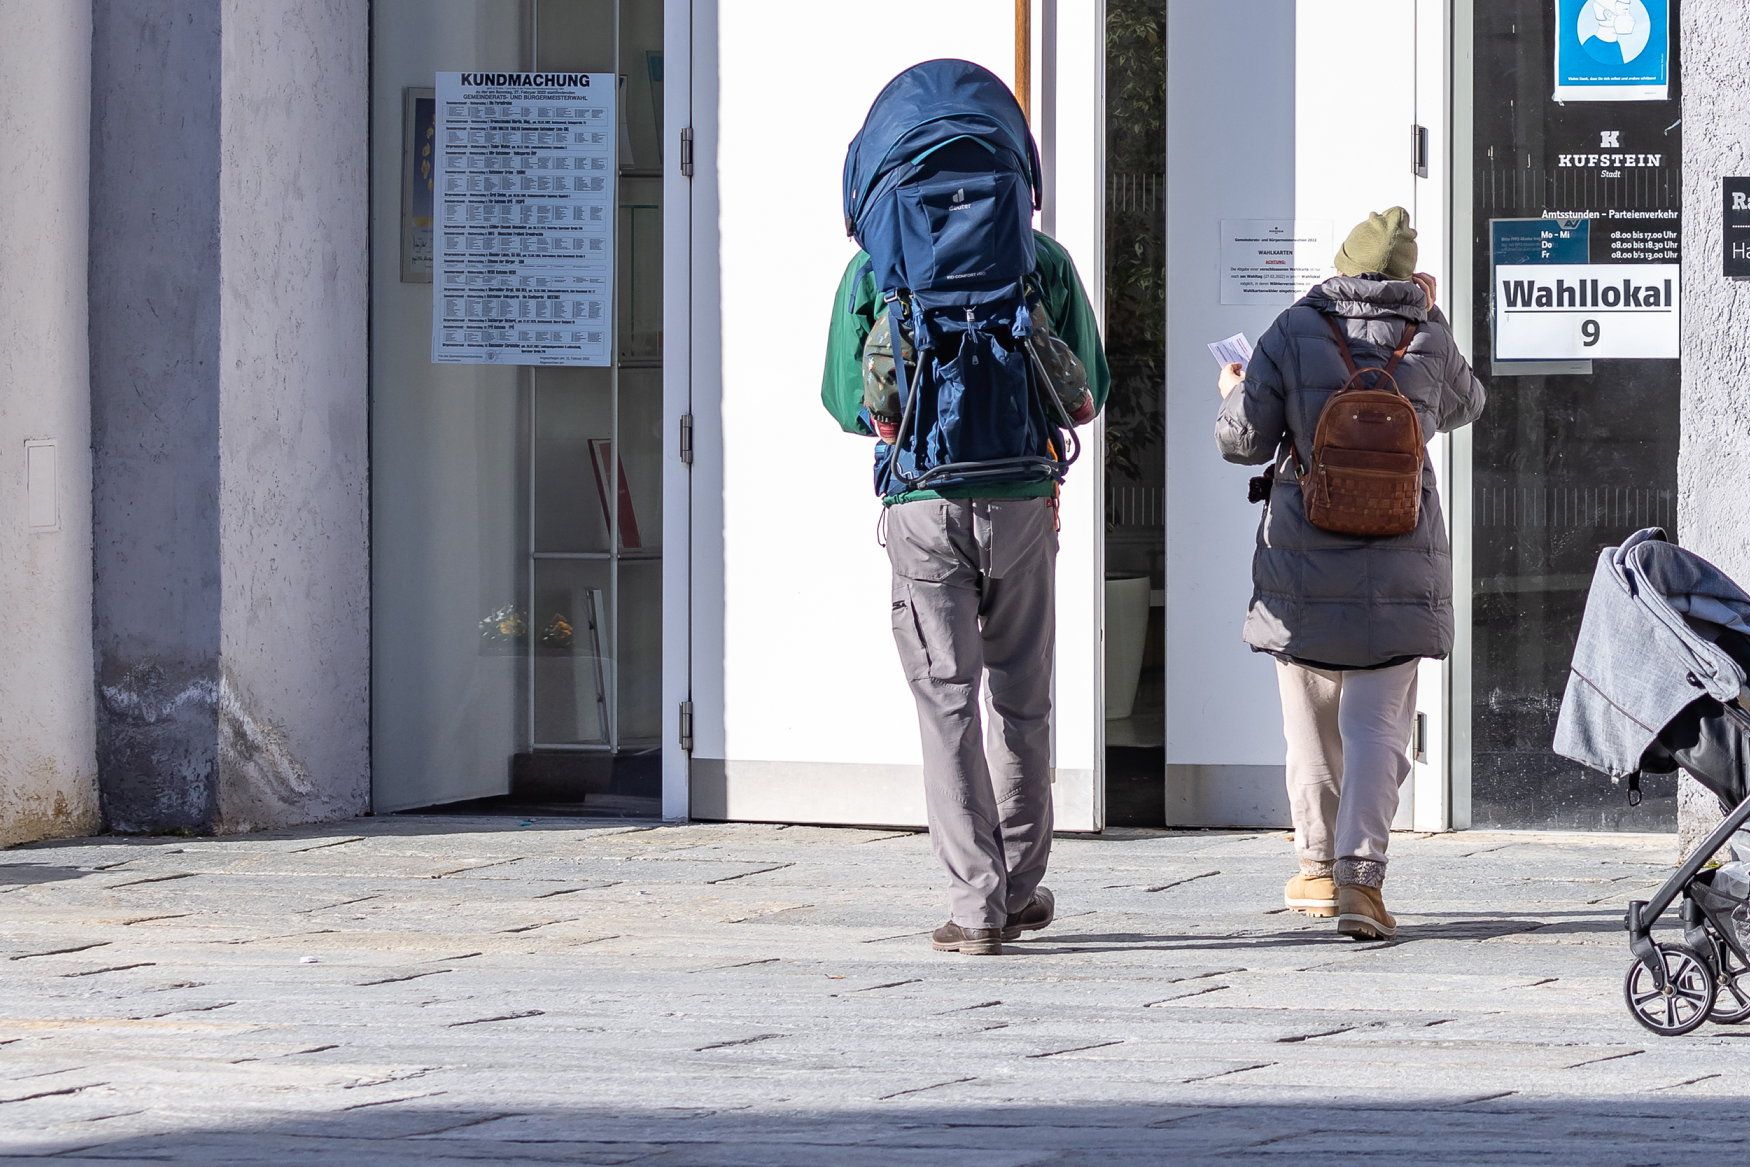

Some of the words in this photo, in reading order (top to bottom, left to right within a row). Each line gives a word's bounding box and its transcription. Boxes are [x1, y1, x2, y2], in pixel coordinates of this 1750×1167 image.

[461, 73, 590, 87] KUNDMACHUNG
[1600, 131, 1620, 148] K
[1558, 154, 1661, 167] KUFSTEIN
[1600, 170, 1621, 178] Stadt
[1541, 210, 1600, 219] Amtsstunden
[1608, 210, 1678, 219] Parteienverkehr
[1541, 231, 1553, 239] Mo
[1560, 231, 1570, 239] Mi
[1611, 231, 1631, 239] 08.00
[1632, 231, 1644, 239] bis
[1644, 232, 1662, 240] 17.00
[1663, 231, 1677, 239] Uhr
[1541, 241, 1552, 249] Do
[1611, 241, 1632, 249] 08.00
[1633, 241, 1644, 249] bis
[1645, 241, 1663, 250] 18.30
[1664, 241, 1678, 249] Uhr
[1541, 250, 1550, 259] Fr
[1611, 251, 1632, 259] 08.00
[1645, 252, 1663, 261] 13.00
[1664, 251, 1678, 259] Uhr
[1502, 278, 1672, 308] Wahllokal
[1581, 319, 1601, 347] 9
